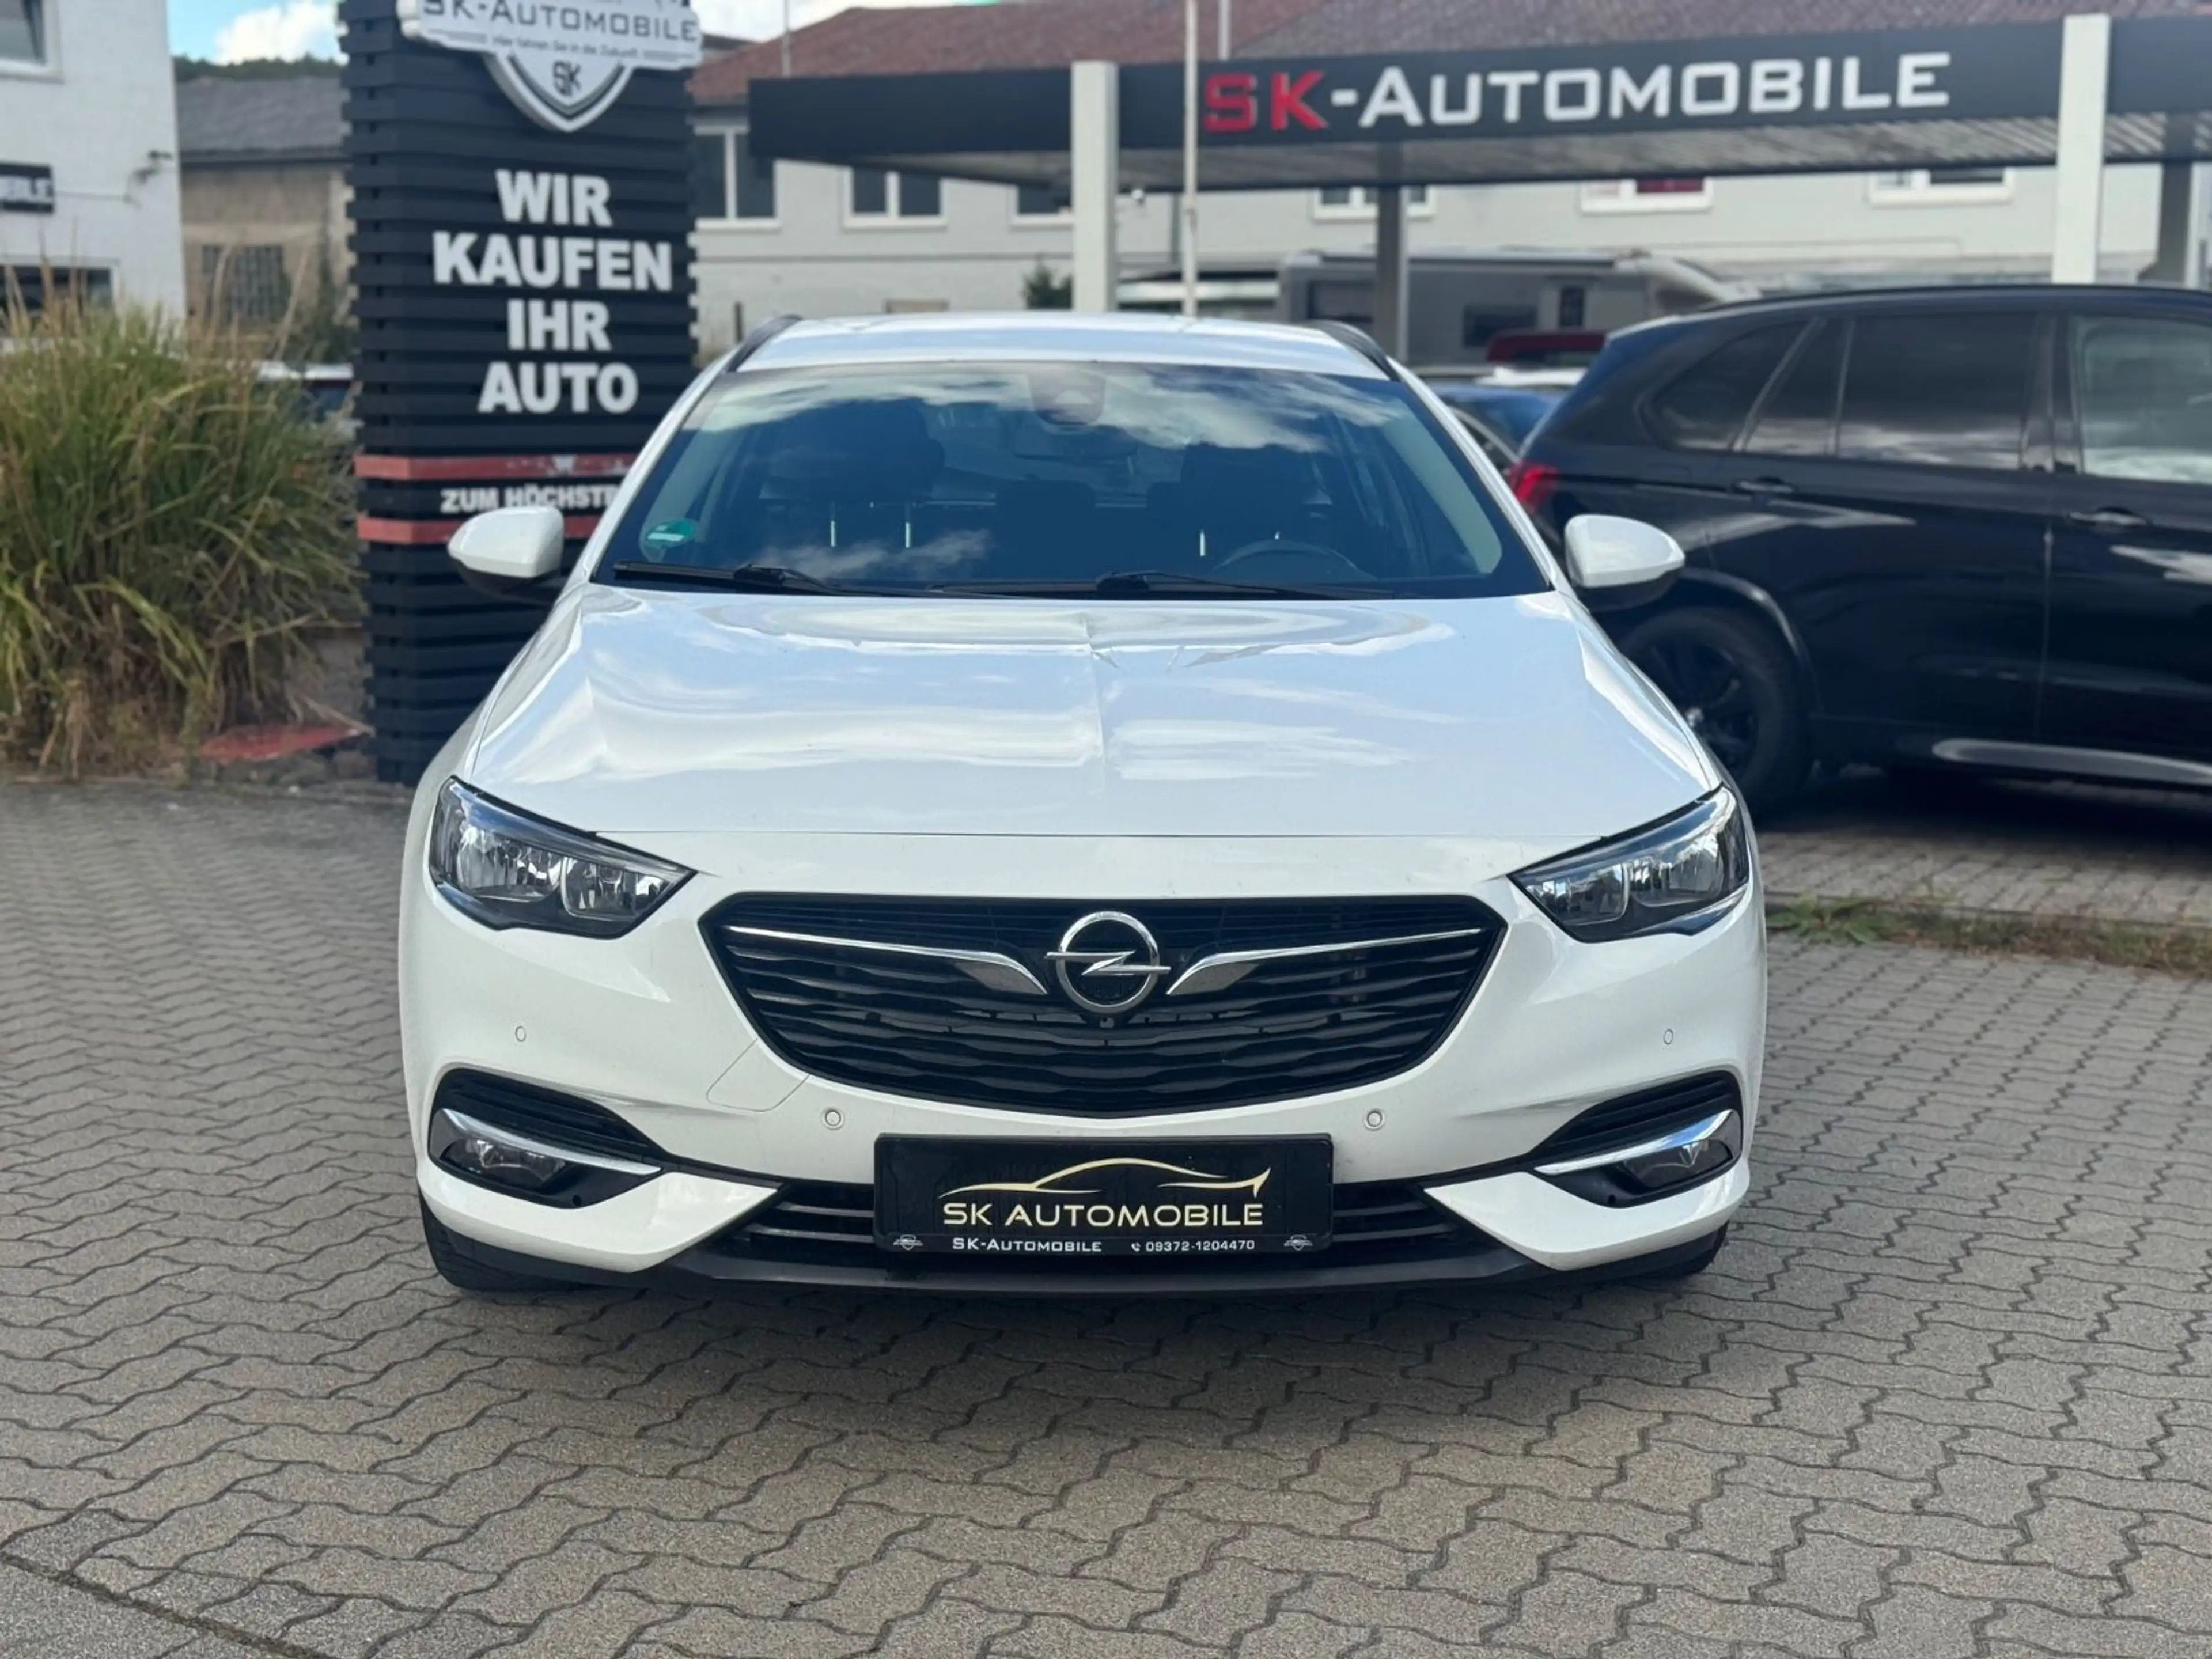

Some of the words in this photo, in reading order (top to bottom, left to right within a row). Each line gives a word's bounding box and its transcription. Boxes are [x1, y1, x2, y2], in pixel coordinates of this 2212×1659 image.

[1204, 52, 1951, 132] SK-AUTOMOBILE
[495, 169, 612, 226] WIR
[433, 230, 672, 291] KAUFEN
[507, 298, 612, 351] IHR
[477, 361, 639, 414] AUTO
[440, 487, 499, 513] ZUM
[943, 1203, 993, 1226] SK
[1005, 1203, 1263, 1228] AUTOMOBILE
[952, 1237, 1102, 1252] SK-AUTOMOBILE
[1145, 1240, 1255, 1252] 09372-1204470
